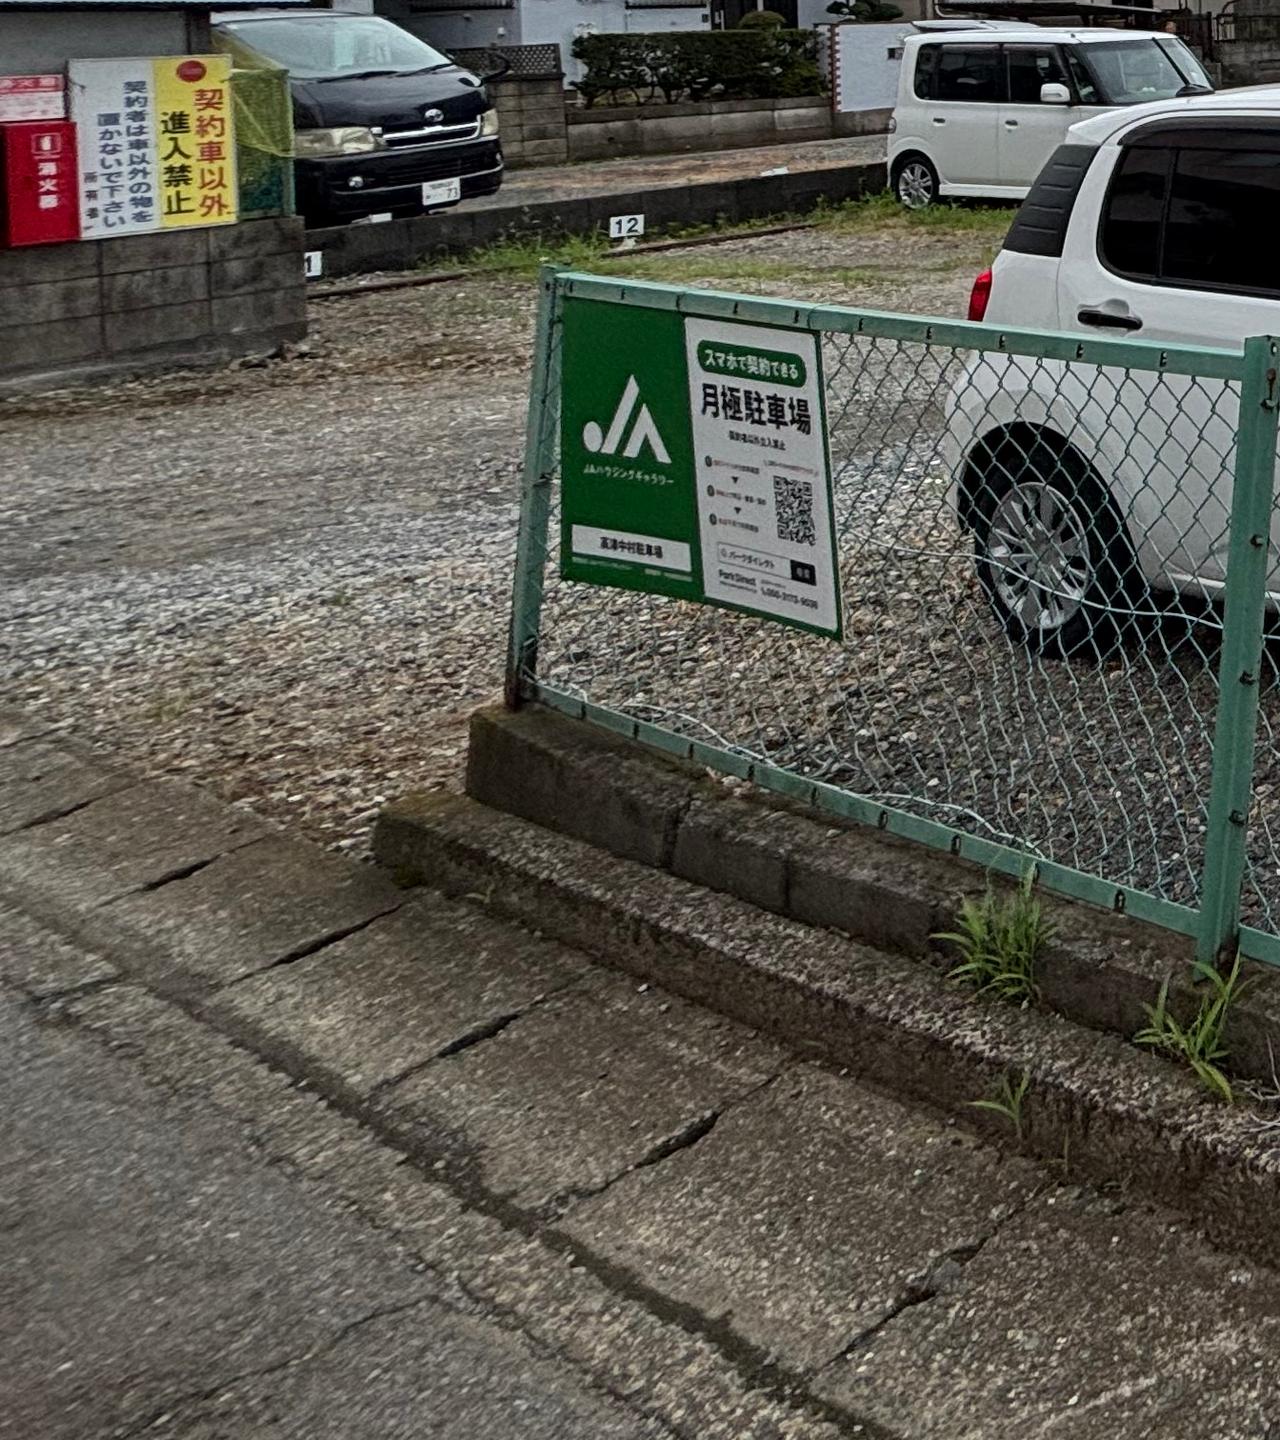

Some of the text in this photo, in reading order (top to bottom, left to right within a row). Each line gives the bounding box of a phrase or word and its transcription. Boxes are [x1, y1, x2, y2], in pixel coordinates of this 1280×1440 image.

[123, 80, 153, 223] 契約者は車以外の物を
[161, 111, 195, 215] 進入禁止
[194, 88, 229, 217] 契約車以外
[615, 217, 639, 234] 12
[704, 349, 799, 379] スマホで契約できる
[701, 383, 812, 436] 月極駐車場
